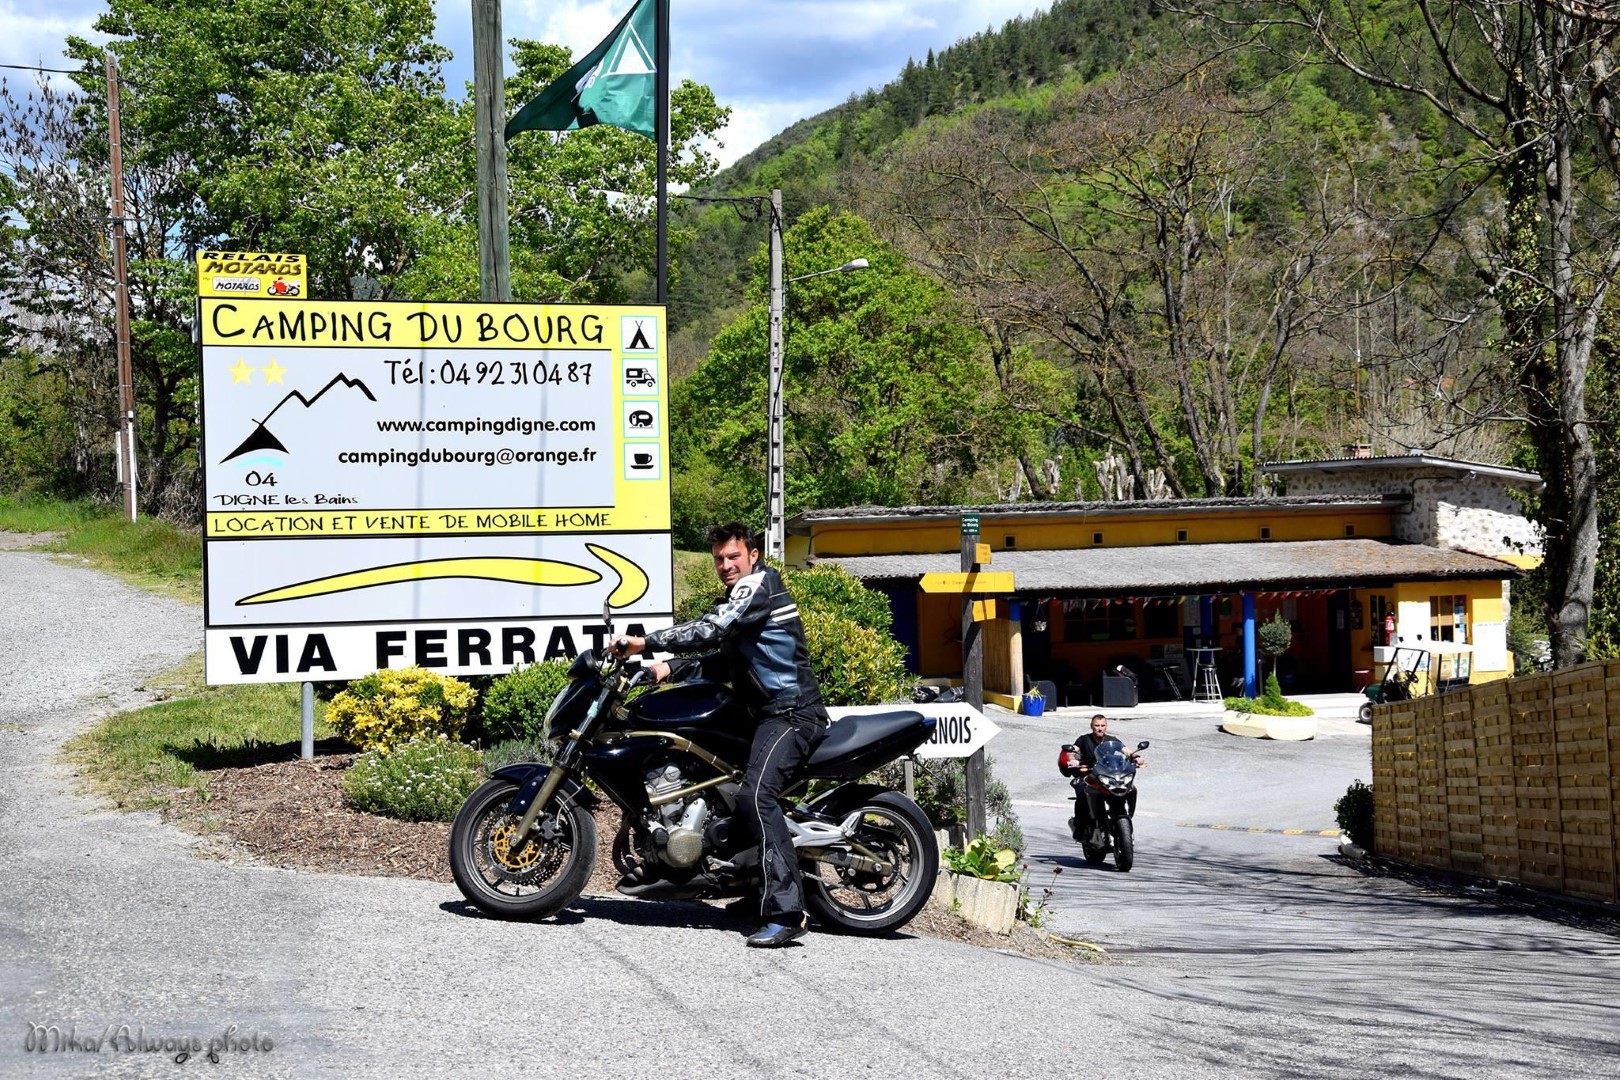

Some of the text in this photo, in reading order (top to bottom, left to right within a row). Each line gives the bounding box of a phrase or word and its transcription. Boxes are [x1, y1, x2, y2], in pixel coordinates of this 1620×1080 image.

[202, 252, 299, 262] RELAIS
[204, 261, 301, 275] MOTARDS
[215, 282, 259, 290] MOTARDS
[406, 311, 462, 343] DU
[476, 312, 603, 345] BOURG
[376, 416, 596, 436] www.campingdigne.com
[338, 447, 597, 467] campingdubourg@orange.fr
[245, 470, 278, 487] 04
[213, 493, 358, 506] DIGNE les Bains
[214, 512, 612, 533] LOCATION ET VENTE DE MOBILE HOME
[229, 633, 337, 675] VIA
